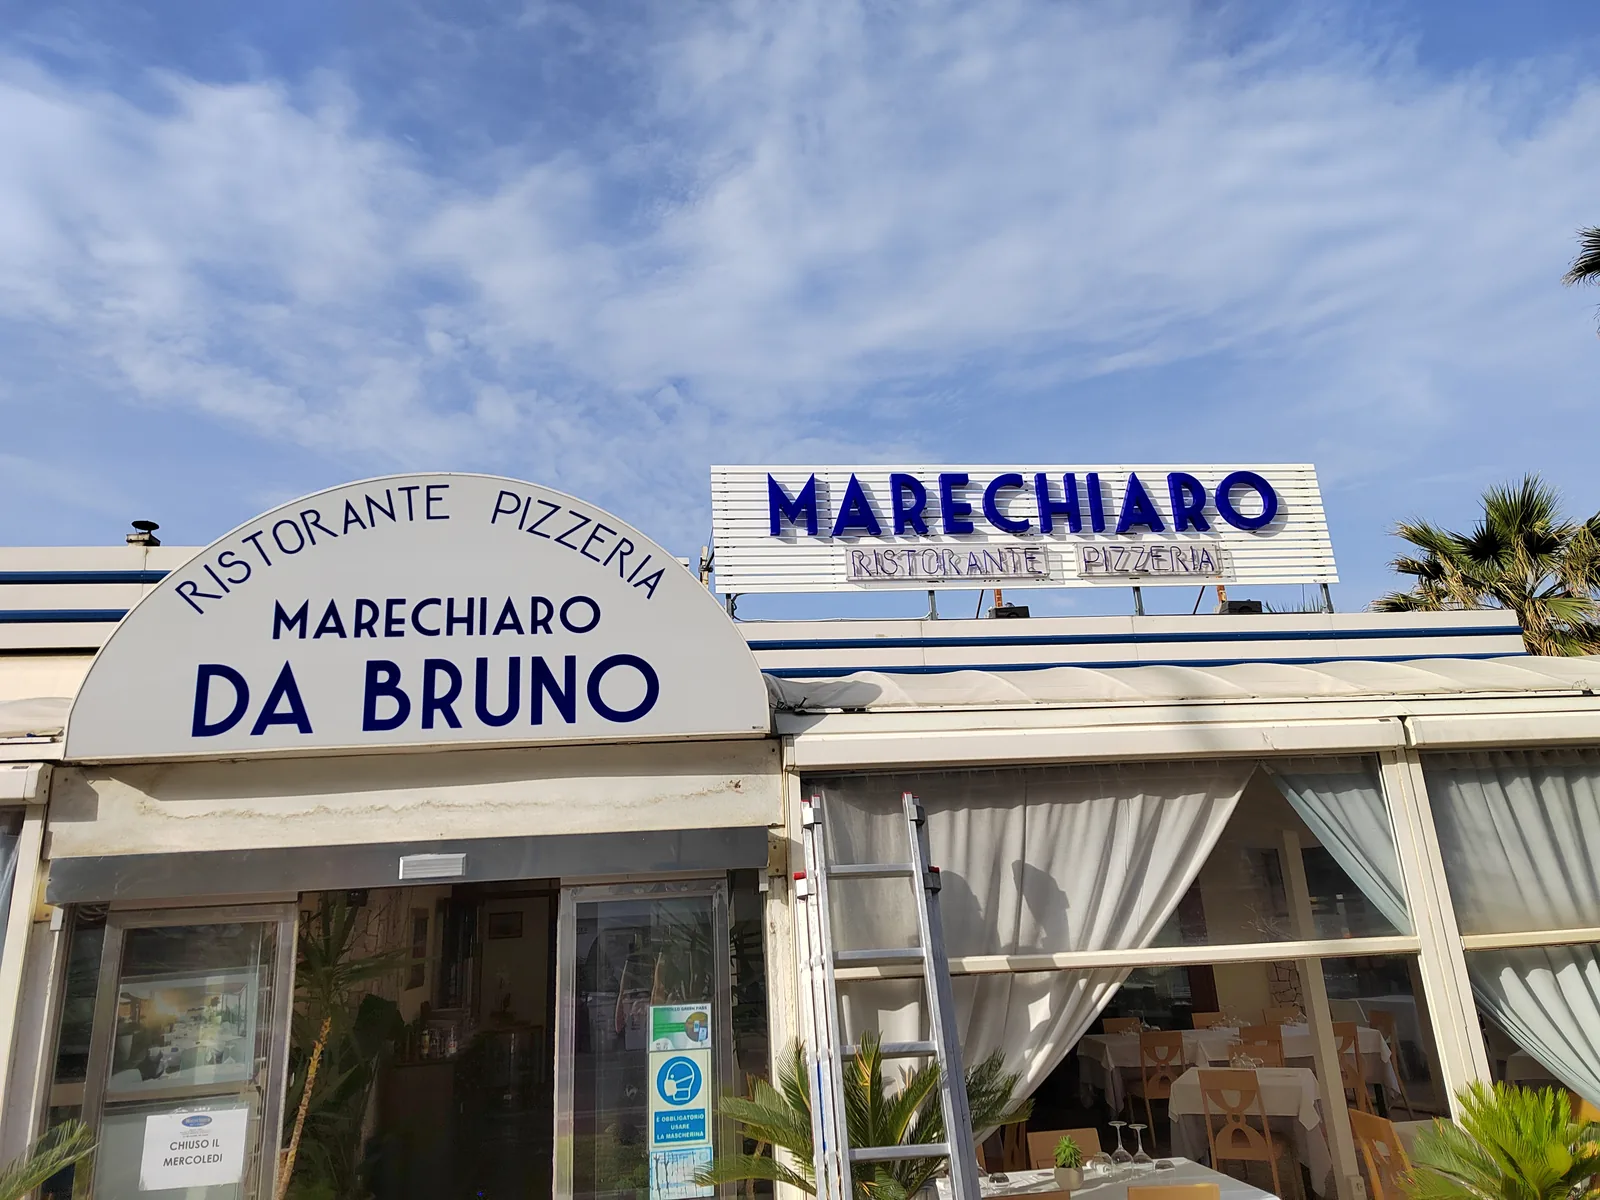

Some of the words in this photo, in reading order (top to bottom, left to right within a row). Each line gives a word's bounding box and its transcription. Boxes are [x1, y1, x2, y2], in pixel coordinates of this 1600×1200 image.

[767, 470, 1278, 537] MARECHIARO
[175, 485, 450, 614] RISTORANTE
[491, 490, 666, 600] PIZZERIA
[852, 547, 1043, 577] RISTORANTE
[1083, 546, 1214, 573] PIZZERIA
[273, 596, 600, 640] MARECHIARO
[192, 660, 313, 737] DA
[362, 654, 659, 732] BRUNO
[661, 1113, 704, 1122] OBBLIGATORIO
[169, 1139, 209, 1151] CHIUSO
[212, 1138, 220, 1148] IL
[665, 1130, 704, 1139] MASCHERINA
[163, 1153, 223, 1167] MERCOLEDI
